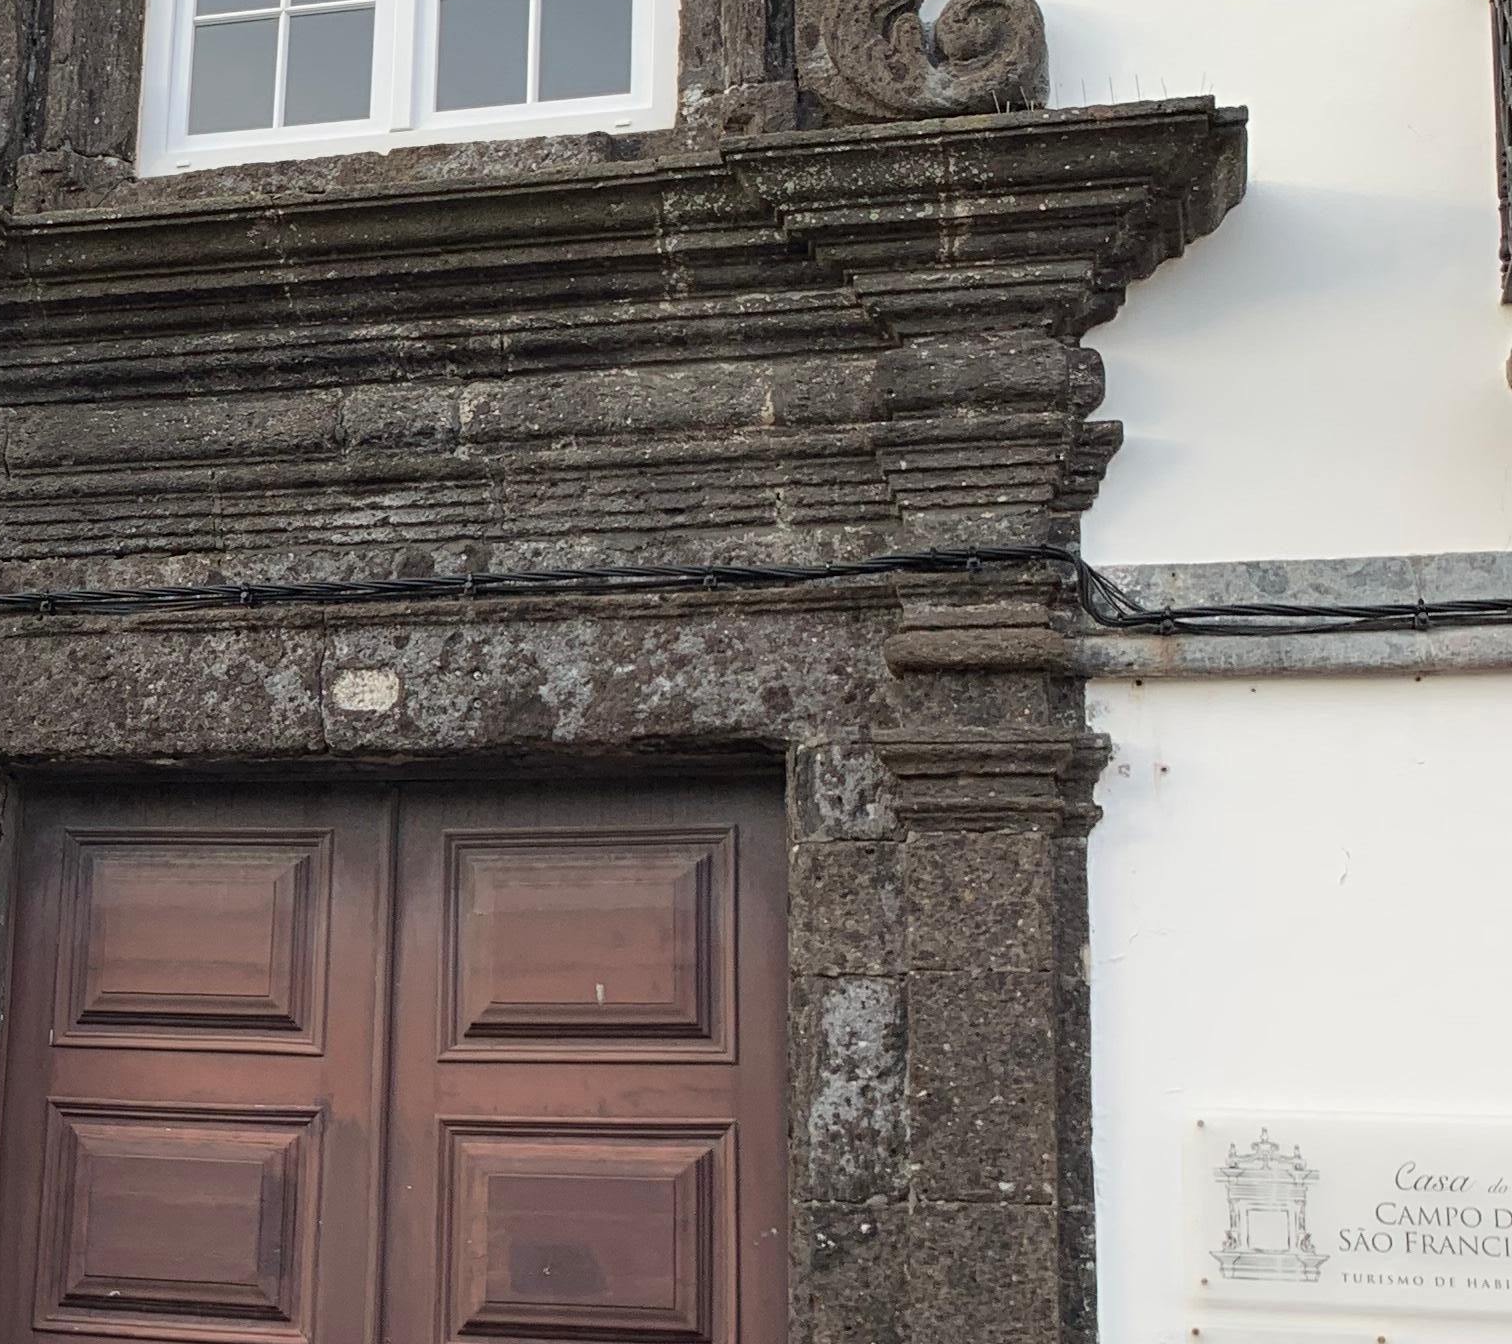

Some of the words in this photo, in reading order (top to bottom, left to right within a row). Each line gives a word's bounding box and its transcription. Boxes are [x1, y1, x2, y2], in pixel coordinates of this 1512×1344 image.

[1395, 1160, 1471, 1193] Casa
[1487, 1177, 1509, 1194] do
[1375, 1201, 1482, 1229] CAMPO
[1338, 1227, 1393, 1254] SÃO
[1341, 1272, 1425, 1287] TURISMO
[1434, 1276, 1456, 1288] DE
